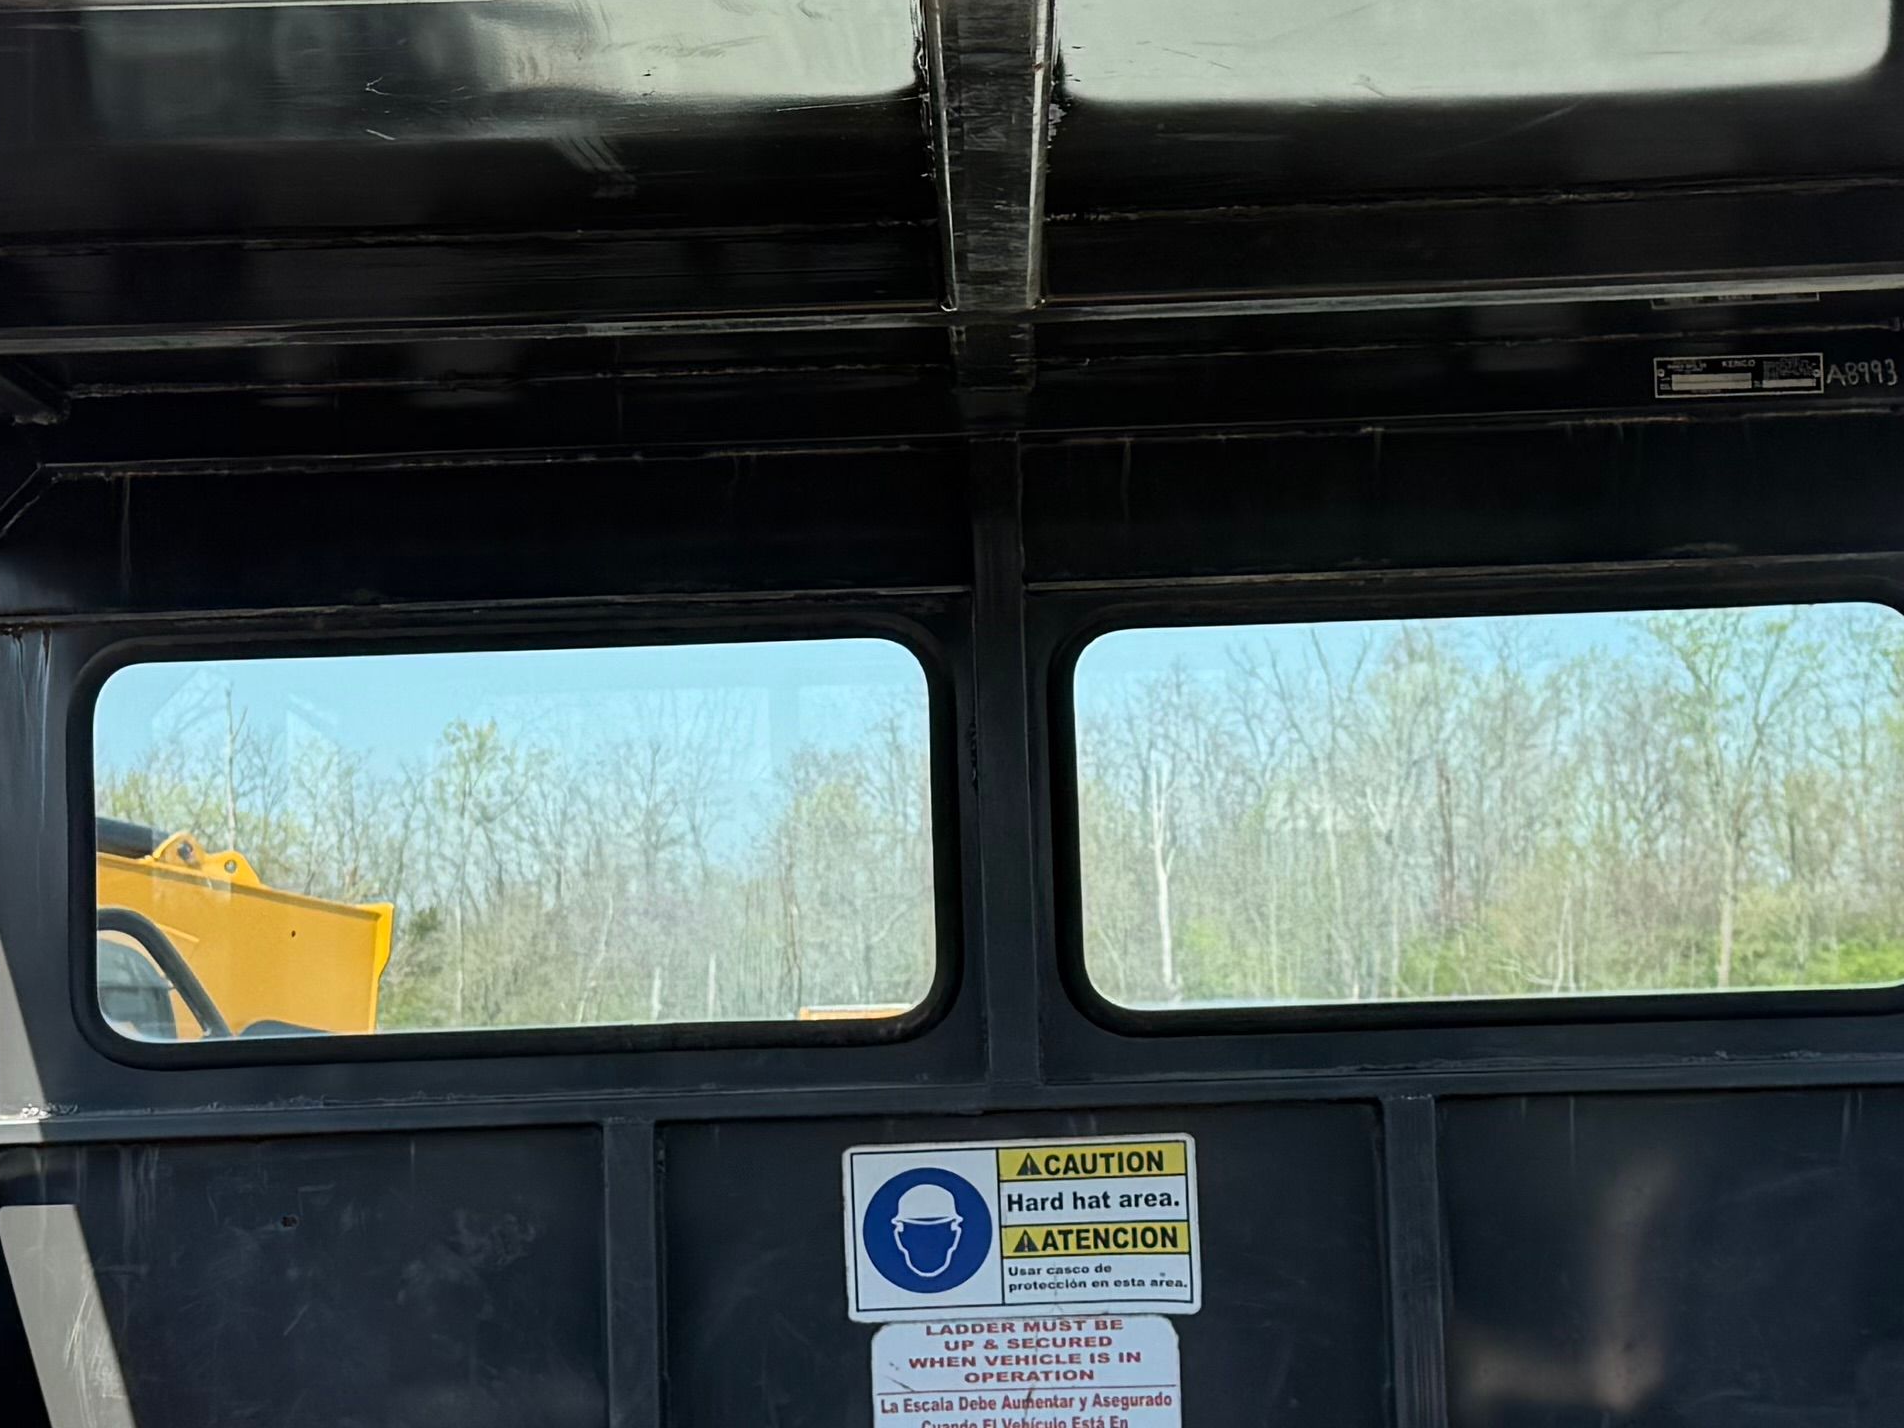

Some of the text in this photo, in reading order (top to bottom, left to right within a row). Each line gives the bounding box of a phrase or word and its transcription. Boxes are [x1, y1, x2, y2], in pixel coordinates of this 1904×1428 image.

[1826, 358, 1898, 387] A8993
[1044, 1150, 1164, 1175] CAUTION
[1007, 1191, 1179, 1212] Hard hat area.
[1041, 1226, 1178, 1251] ATENCION
[1008, 1263, 1112, 1276] Usar casco de
[1008, 1278, 1087, 1293] protección
[1113, 1277, 1145, 1287] esta
[925, 1319, 1123, 1336] LADDER MUST BE
[944, 1336, 1113, 1351] UP & SECURED
[908, 1351, 1142, 1369] WHEN VEHICLE IS IN
[964, 1369, 1095, 1383] OPERATION
[881, 1391, 1173, 1414] La Escala Debe Aumentar y Asegurado
